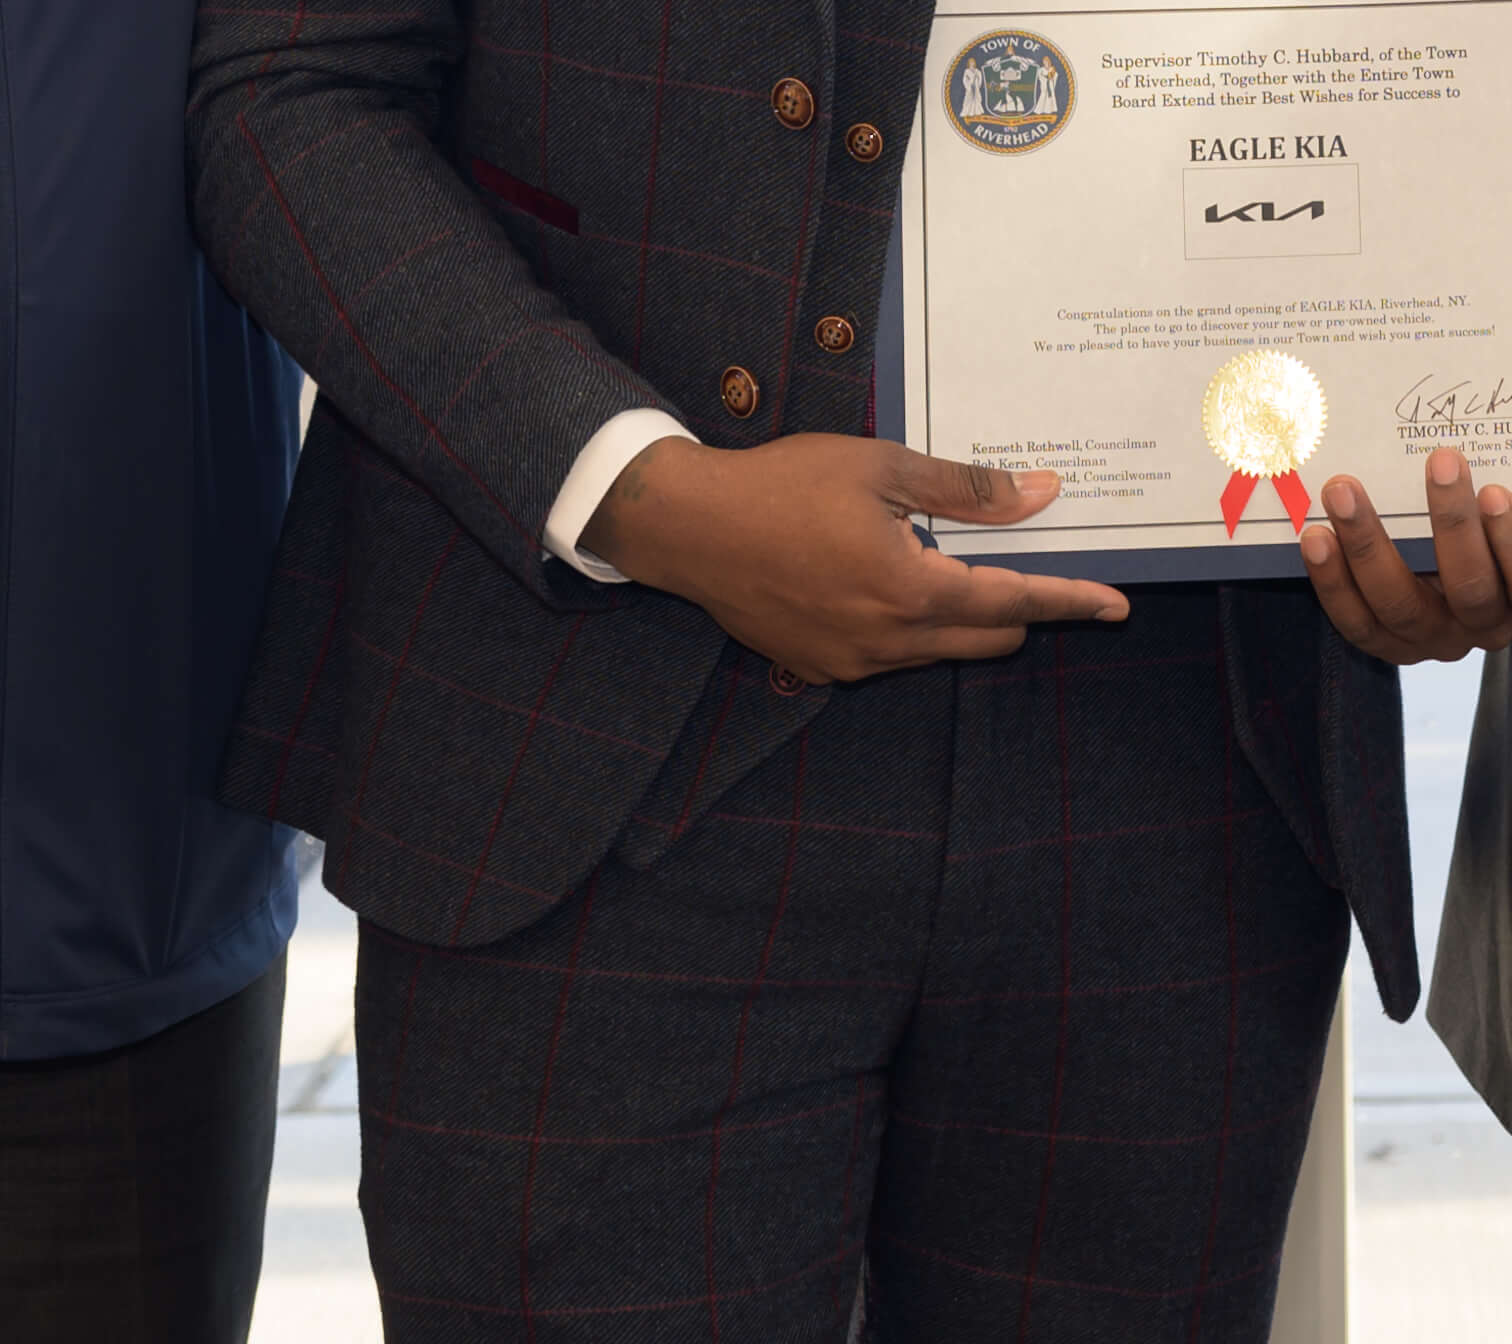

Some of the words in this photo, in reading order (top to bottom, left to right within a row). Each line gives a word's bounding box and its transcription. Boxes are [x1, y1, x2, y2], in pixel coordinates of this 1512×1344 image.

[979, 37, 1020, 54] TOWN
[1023, 39, 1041, 53] OF
[1101, 53, 1192, 71] Supervisor
[1197, 50, 1268, 68] Timothy
[1273, 50, 1291, 64] C.
[1296, 47, 1374, 64] Hubbard,
[1379, 48, 1394, 61] of
[1398, 47, 1422, 61] the
[1426, 46, 1468, 59] Town
[1115, 75, 1131, 89] of
[1134, 73, 1216, 89] Riverhead,
[1220, 71, 1288, 89] Together
[1292, 70, 1326, 84] with
[1331, 69, 1355, 83] the
[1360, 67, 1408, 82] Entire
[1412, 66, 1455, 80] Town
[1112, 94, 1156, 109] Board
[1162, 92, 1215, 107] Extend
[1220, 91, 1257, 106] their
[1262, 90, 1295, 105] Best
[1299, 88, 1353, 103] Wishes
[1358, 88, 1379, 102] for
[1383, 87, 1441, 101] Success
[1446, 86, 1461, 99] to
[974, 123, 1049, 145] RIVERHEAD
[1189, 137, 1286, 162] EAGLE
[1294, 135, 1348, 159] KIA
[1205, 200, 1325, 223] KIA
[1057, 307, 1153, 321] Congratulations
[1156, 310, 1171, 318] on
[1174, 306, 1193, 317] the
[1197, 304, 1231, 318] grand
[1234, 303, 1282, 316] opening
[1285, 302, 1297, 312] of
[1300, 300, 1345, 312] EAGLE
[1448, 295, 1471, 307] NY.
[1093, 323, 1116, 335] The
[1120, 323, 1151, 337] place
[1154, 323, 1166, 333] to
[1169, 323, 1182, 334] go
[1186, 322, 1198, 332] to
[1200, 319, 1248, 331] discover
[1252, 320, 1278, 331] your
[1283, 318, 1306, 328] new
[1310, 318, 1322, 327] or
[1326, 315, 1386, 328] pre-owned
[1390, 312, 1435, 325] vehicle.
[1033, 340, 1053, 352] We
[1056, 343, 1075, 352] are
[1079, 339, 1124, 353] pleased
[1127, 339, 1139, 349] to
[1142, 337, 1170, 349] have
[1173, 338, 1201, 350] your
[1204, 335, 1255, 347] business
[1259, 335, 1270, 345] in
[1273, 336, 1294, 345] our
[1296, 332, 1329, 343] Town
[1333, 331, 1355, 342] and
[1358, 330, 1386, 341] wish
[1390, 330, 1411, 342] you
[1414, 328, 1445, 341] great
[1448, 324, 1496, 337] success!
[1396, 423, 1470, 439] TIMOTHY
[1475, 422, 1488, 436] C.
[972, 442, 1023, 455] Kenneth
[1026, 440, 1083, 454] Rothwell,
[1085, 438, 1157, 451] Councilman
[1468, 440, 1502, 452] Town
[999, 458, 1031, 470] Kern,
[1035, 456, 1107, 469] Councilman
[1084, 470, 1172, 482] Councilwoman
